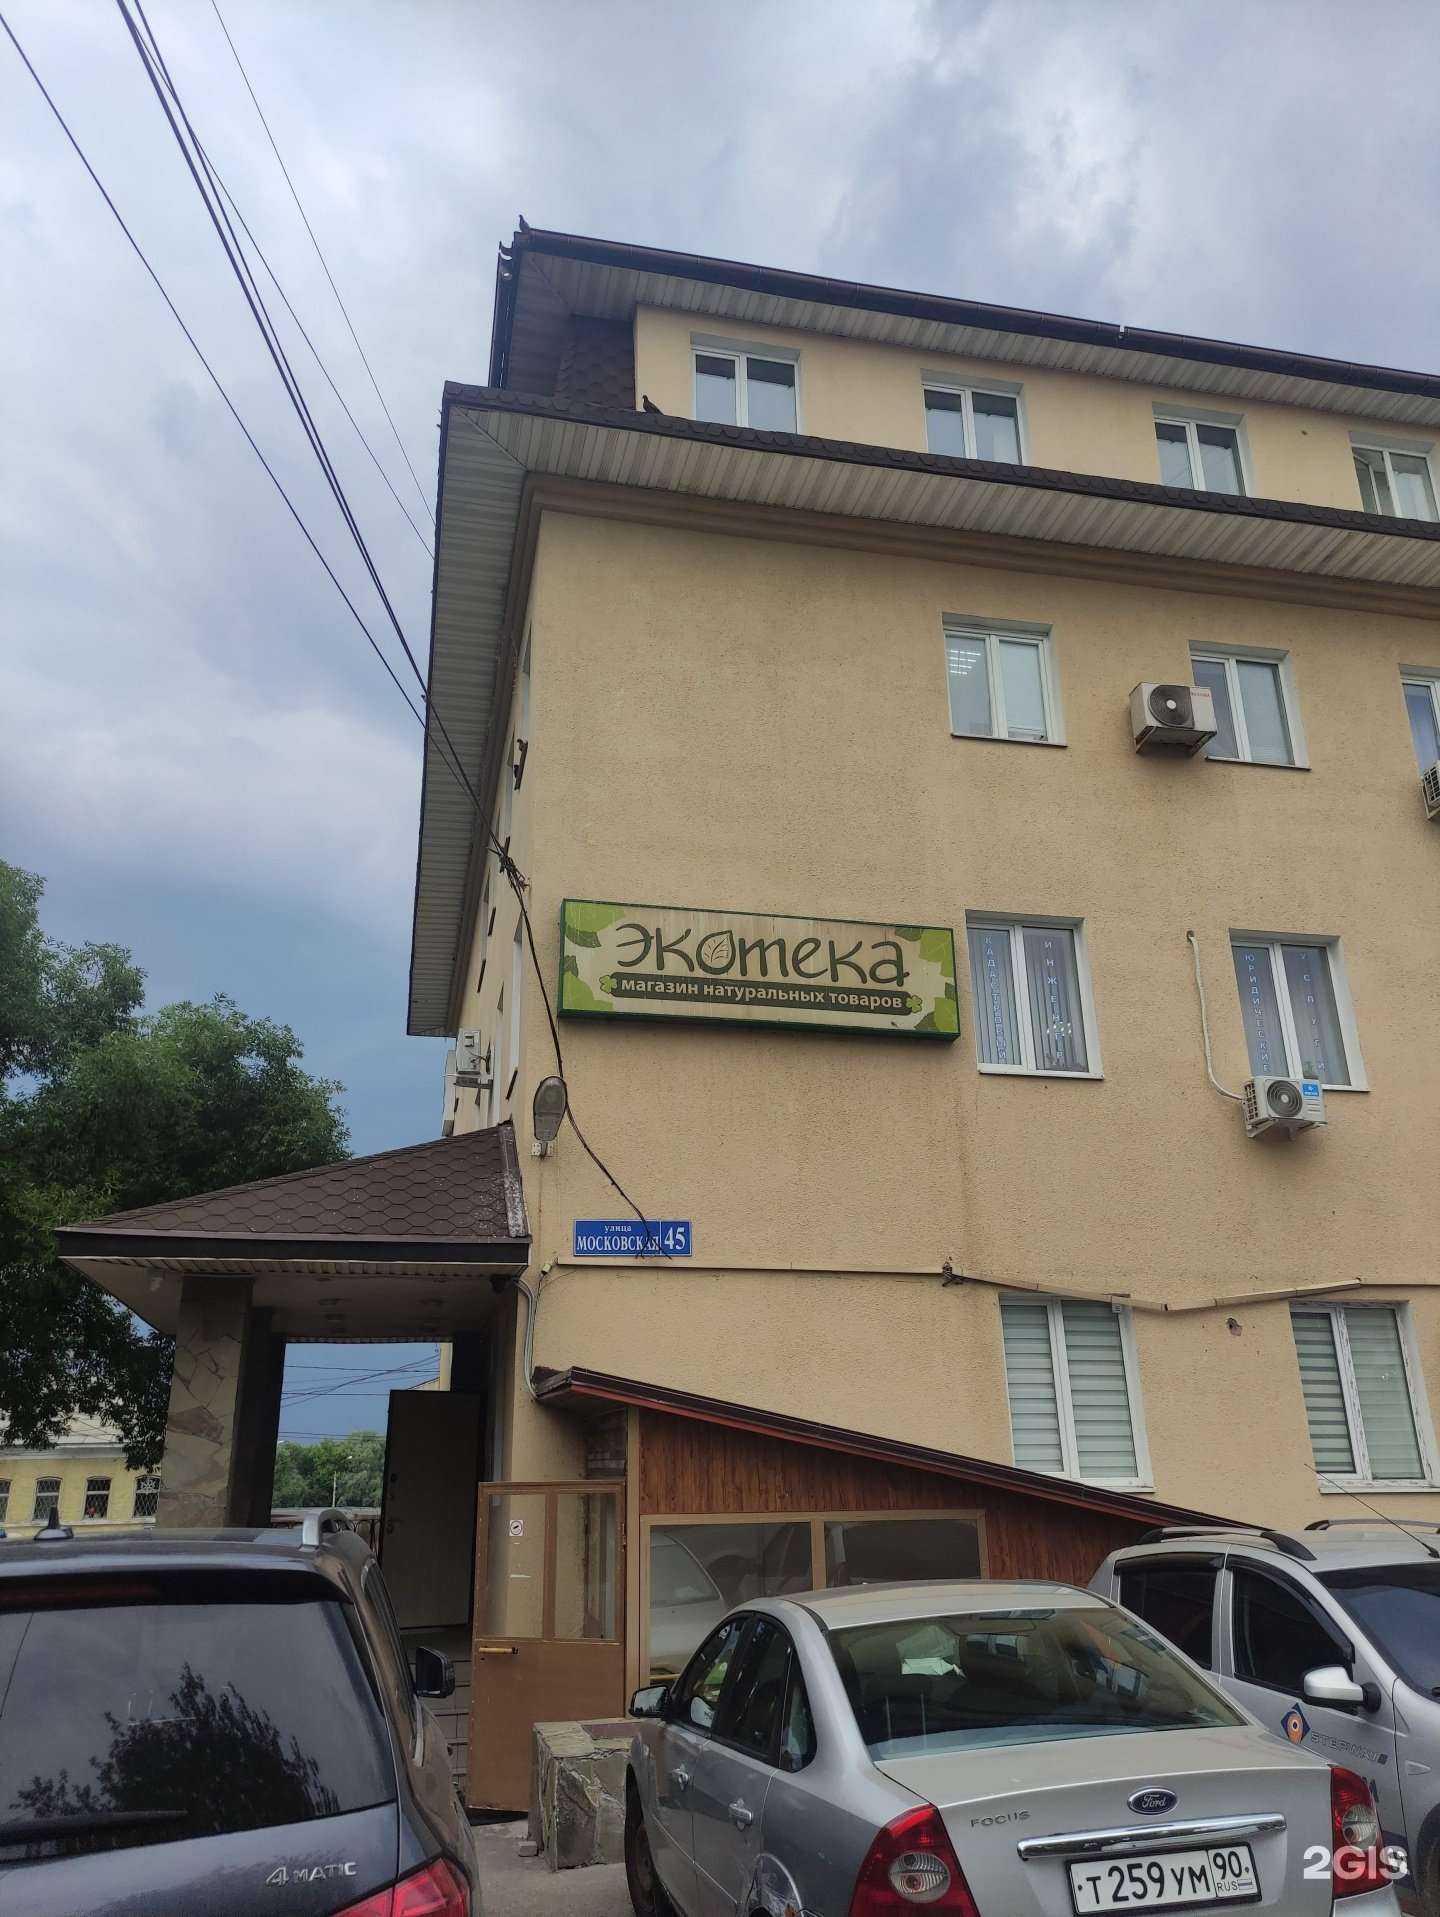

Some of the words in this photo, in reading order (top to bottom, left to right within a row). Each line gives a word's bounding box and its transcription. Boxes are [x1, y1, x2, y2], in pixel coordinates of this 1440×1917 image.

[621, 977, 699, 996] магазин
[703, 983, 826, 1004] натуральных
[829, 994, 903, 1012] товаров
[604, 1224, 632, 1234] улица
[664, 1226, 686, 1250] 45
[970, 1810, 1032, 1828] FOCUS
[1216, 1880, 1238, 1892] RUS
